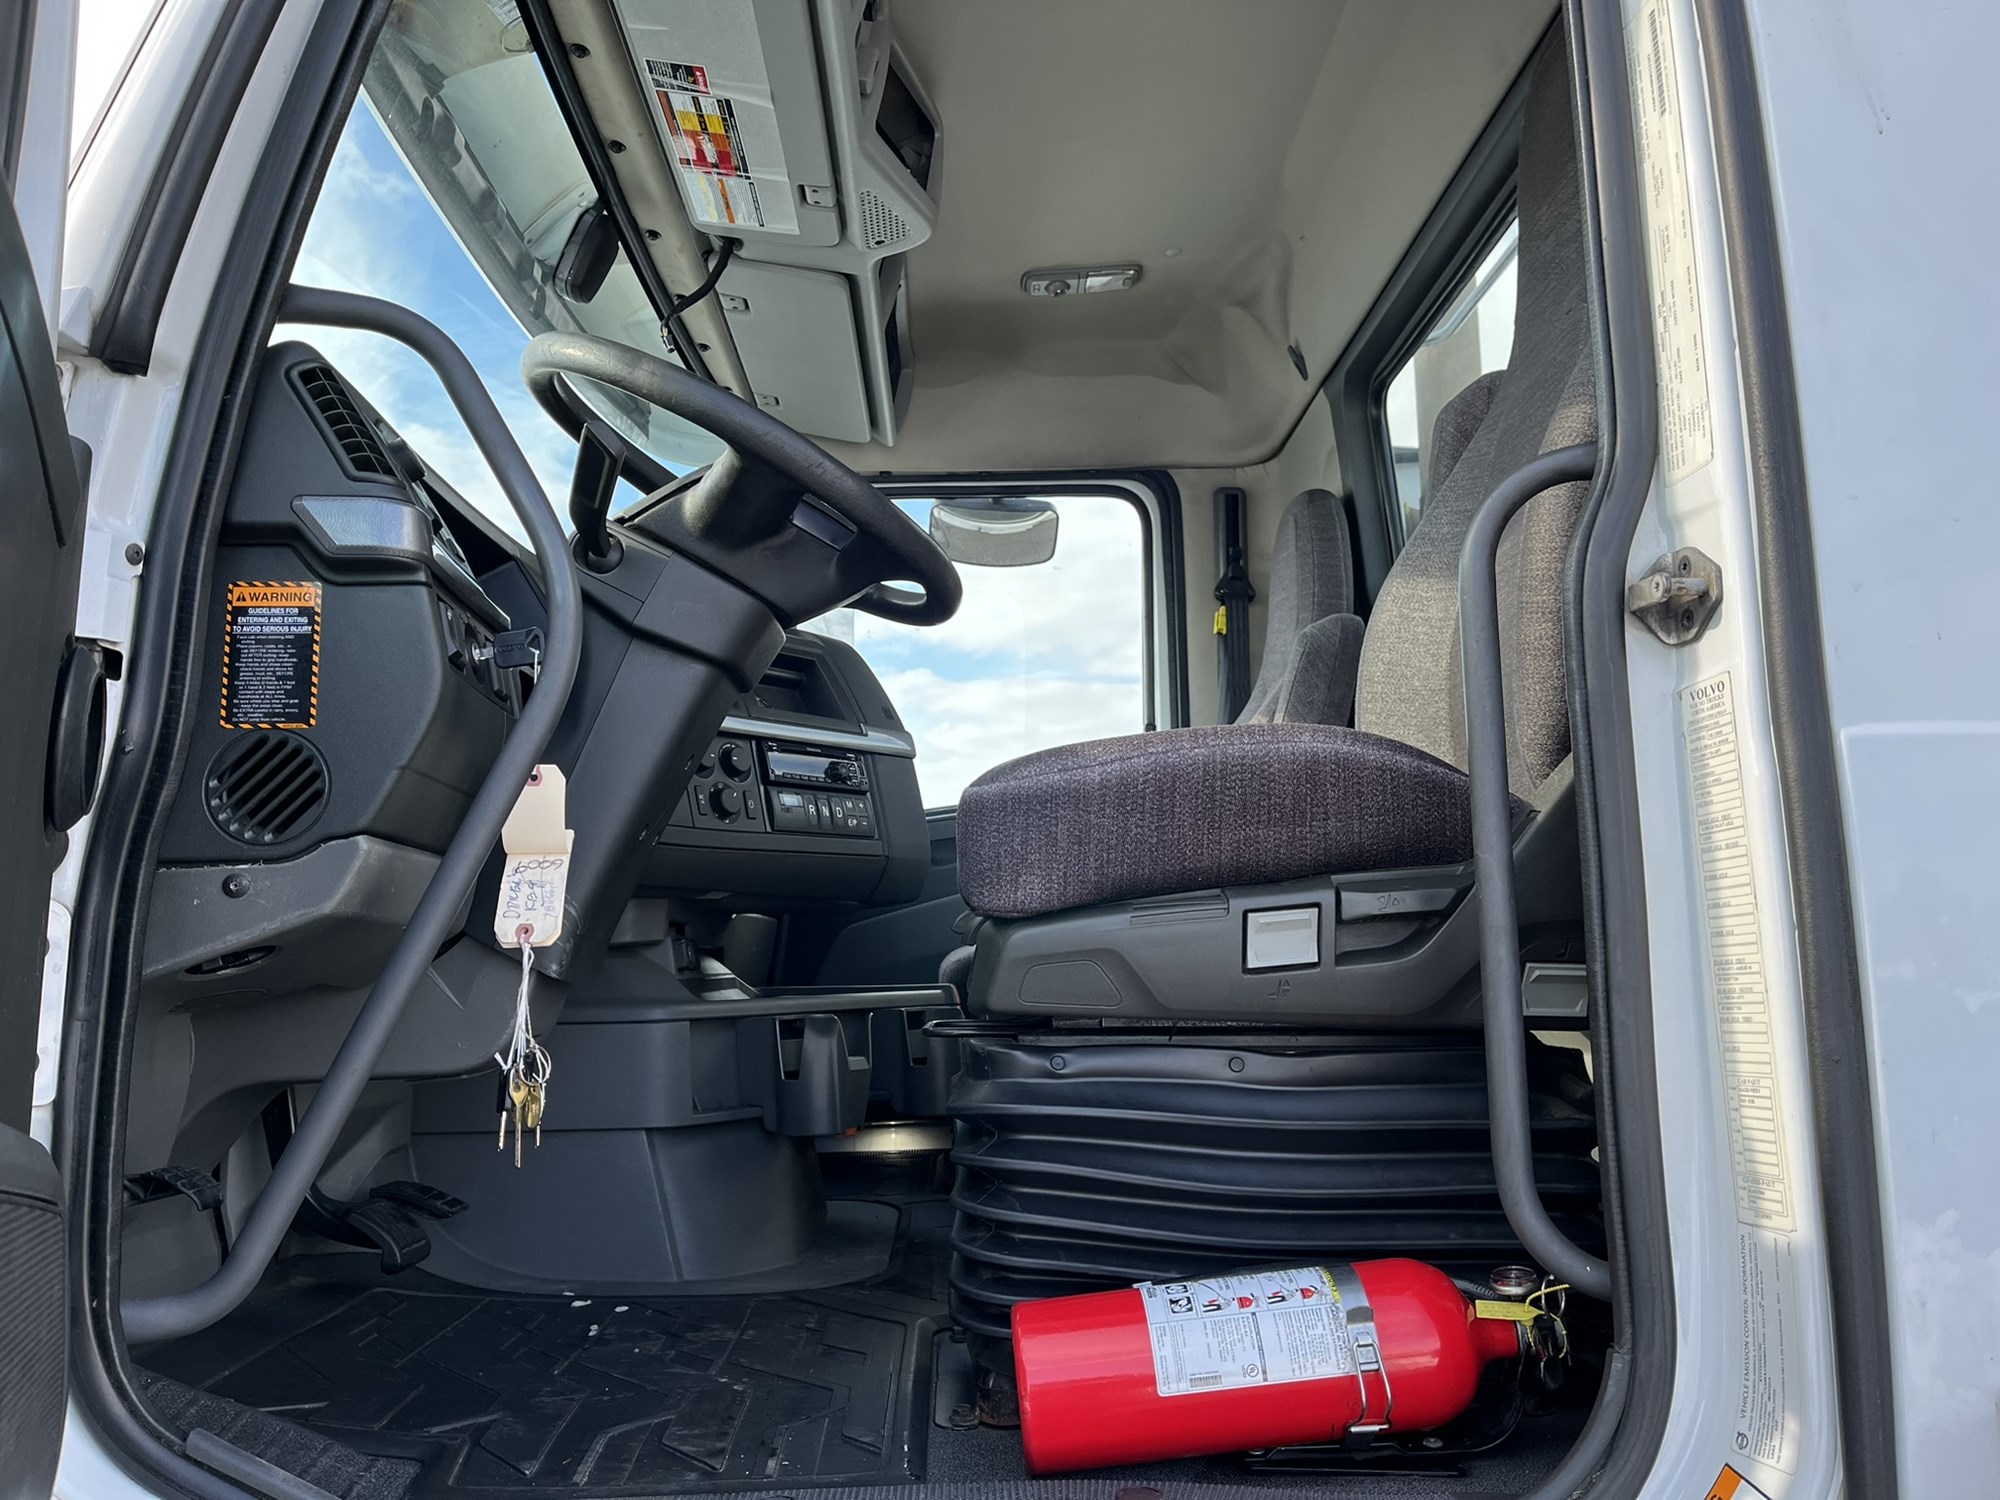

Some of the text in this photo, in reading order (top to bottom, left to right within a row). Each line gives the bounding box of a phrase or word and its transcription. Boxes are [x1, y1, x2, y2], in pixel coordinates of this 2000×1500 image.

[249, 592, 312, 602] WARNING
[1690, 680, 1725, 702] VOLVO
[809, 804, 817, 816] R
[822, 805, 830, 817] N
[836, 806, 843, 818] D
[1740, 1384, 1749, 1419] VEHICLE
